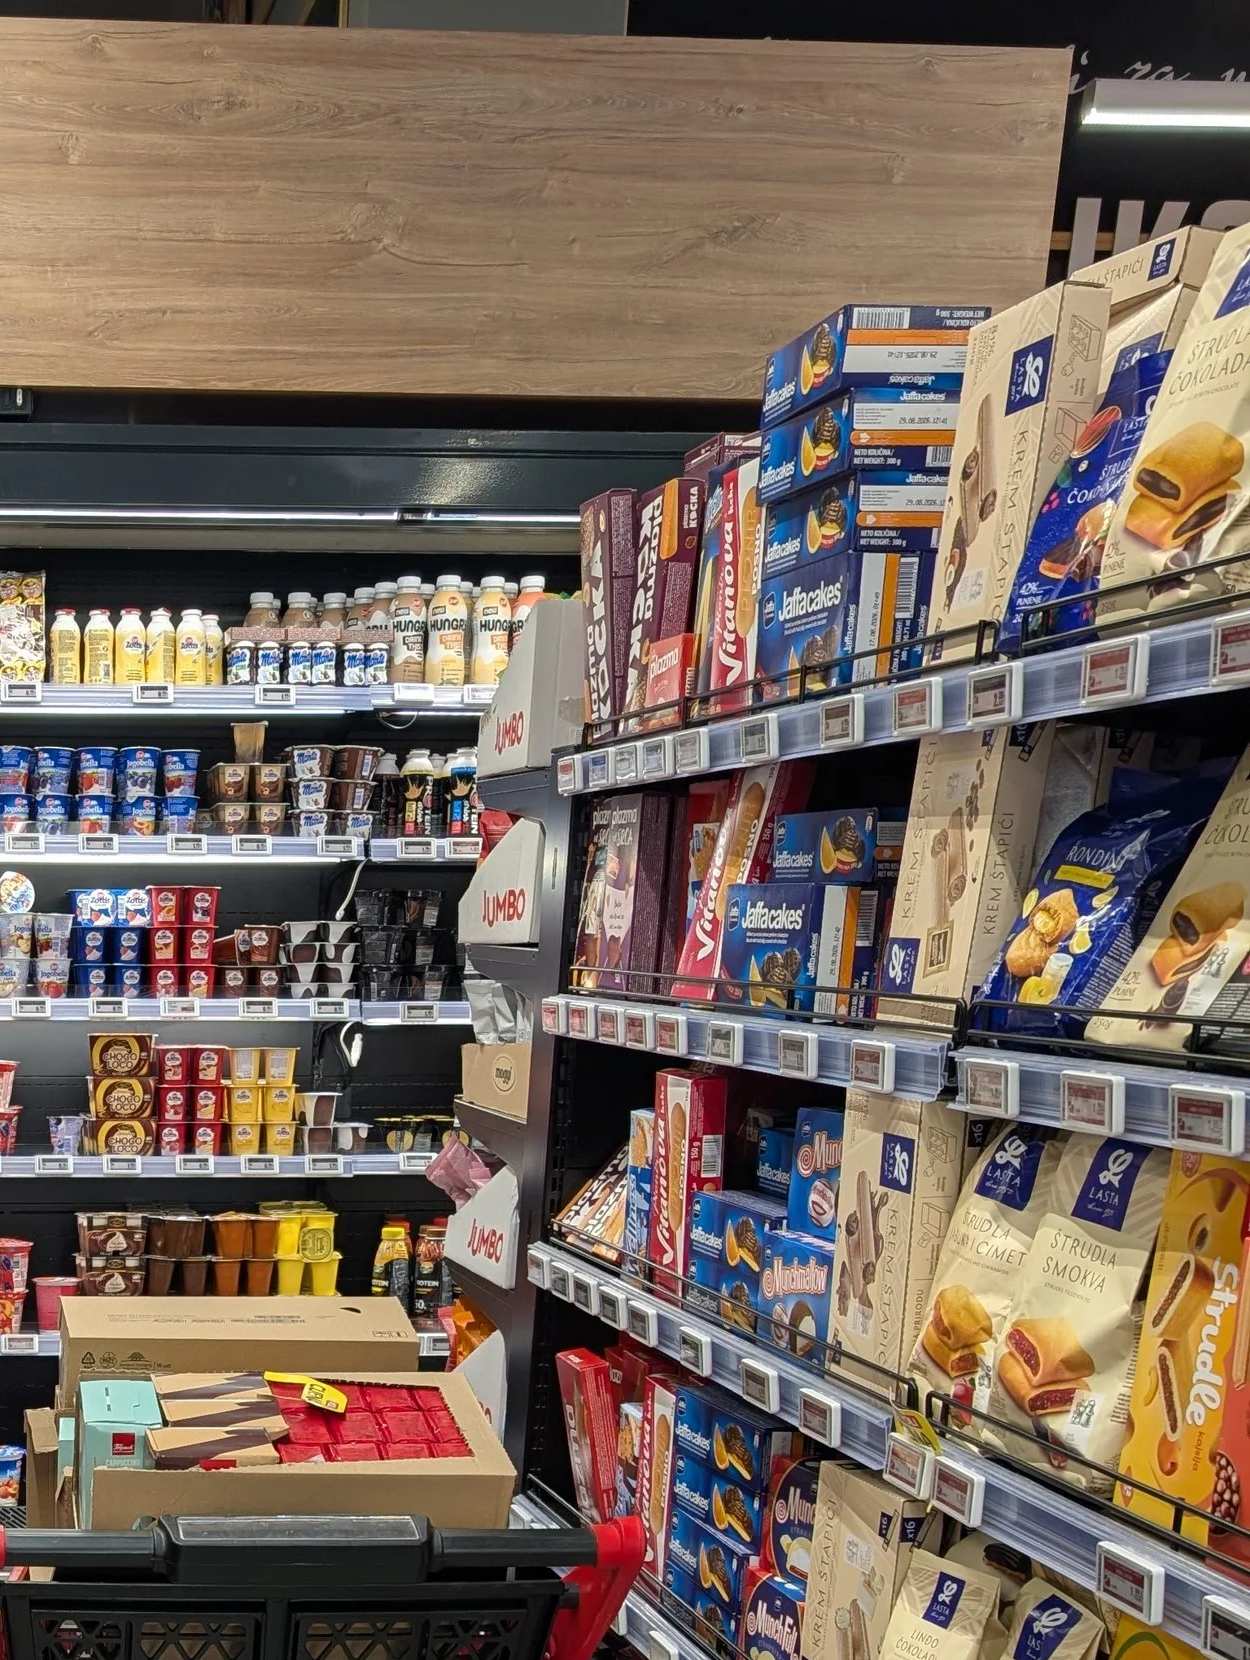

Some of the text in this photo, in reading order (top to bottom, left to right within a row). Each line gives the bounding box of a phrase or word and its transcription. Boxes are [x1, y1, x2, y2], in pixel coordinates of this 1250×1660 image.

[690, 485, 699, 529] KOCKA
[778, 581, 843, 623] Jaffacakes
[494, 710, 524, 756] JUMBO
[901, 850, 920, 920] KREM
[481, 888, 526, 928] JUMBO
[741, 902, 803, 930] Jaffacakes
[983, 881, 1003, 936] KREM
[986, 1165, 1021, 1188] LASTA
[1089, 1186, 1119, 1207] LASTA
[468, 1217, 505, 1264] JUMBO
[1050, 1230, 1116, 1268] ŠTRUDLA
[773, 1257, 828, 1295] Munchmallow
[1042, 1256, 1106, 1294] SMOKVA
[906, 1520, 915, 1541] x16
[812, 1596, 826, 1649] KREM
[932, 1601, 950, 1616] LASTA
